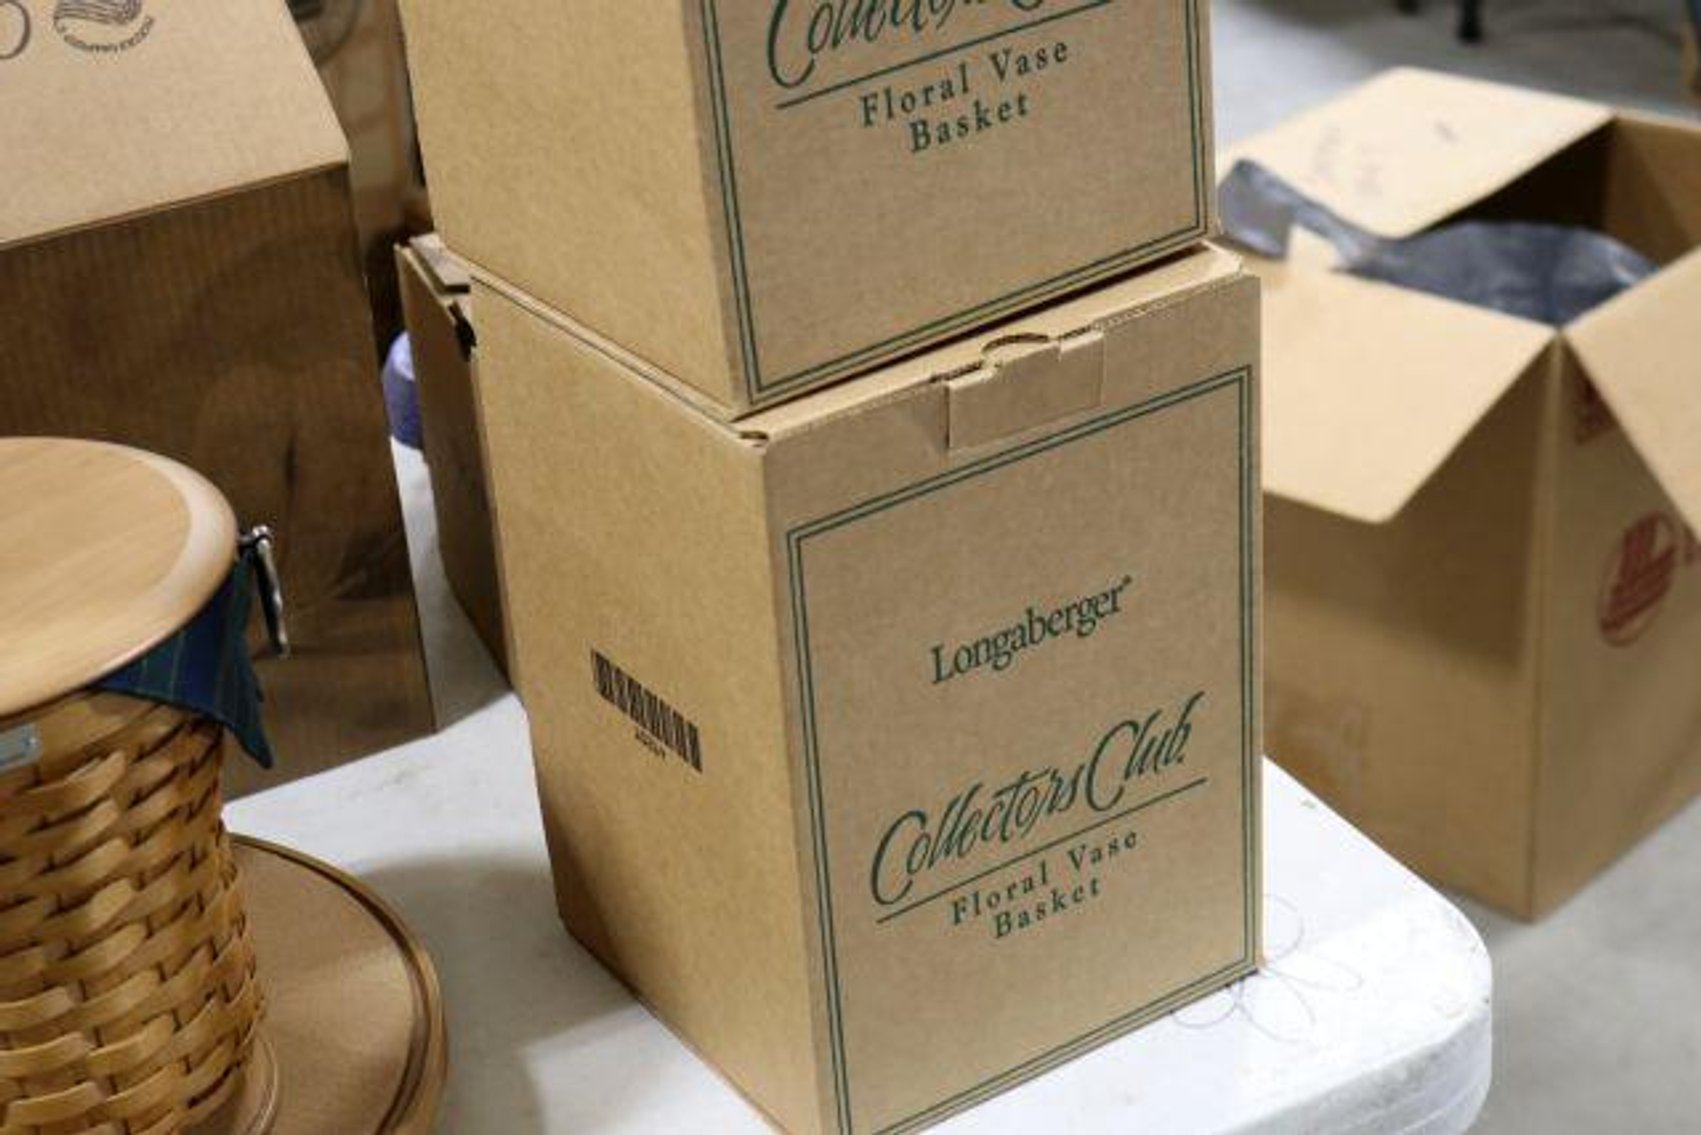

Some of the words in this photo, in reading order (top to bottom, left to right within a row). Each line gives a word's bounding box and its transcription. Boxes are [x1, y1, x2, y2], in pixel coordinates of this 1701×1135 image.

[860, 64, 969, 128] Floral
[989, 40, 1069, 83] Vase
[909, 94, 1029, 153] Basket
[870, 766, 1085, 905] Collectors
[951, 861, 1049, 925] Floral
[1067, 830, 1138, 873] Vase
[994, 879, 1102, 939] Basket
